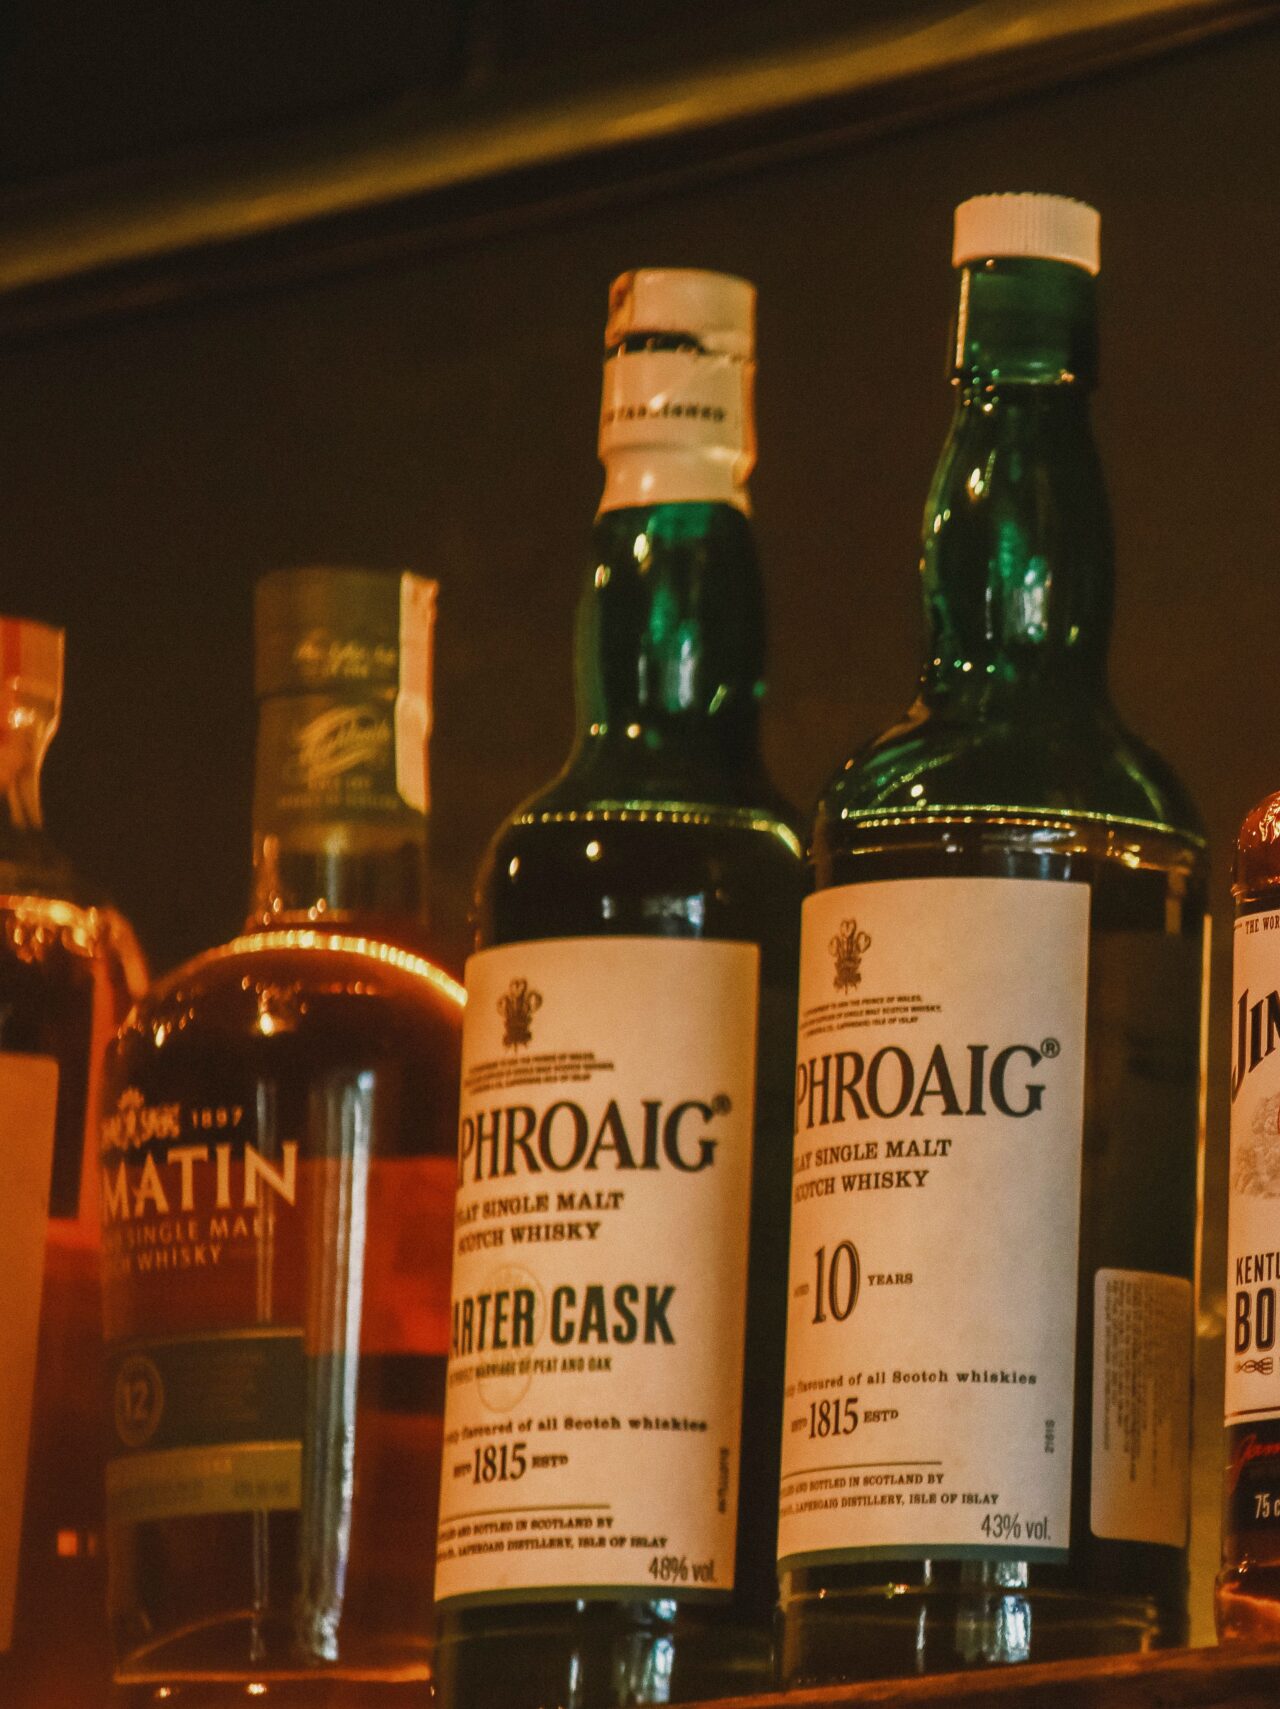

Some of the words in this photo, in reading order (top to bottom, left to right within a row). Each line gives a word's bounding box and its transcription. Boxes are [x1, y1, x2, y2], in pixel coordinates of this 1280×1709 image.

[1245, 918, 1260, 935] THE
[815, 1141, 878, 1166] SINGLE
[885, 1138, 952, 1159] MALT
[841, 1169, 930, 1192] WHISKY
[481, 1193, 549, 1220] SINGLE
[556, 1190, 625, 1212] MALT
[510, 1221, 601, 1246] WHISKY
[811, 1239, 861, 1325] 10
[867, 1273, 914, 1287] YEARS
[550, 1283, 677, 1346] CASK
[560, 1356, 585, 1373] AND
[588, 1355, 613, 1372] OAK
[848, 1372, 863, 1386] of
[866, 1371, 887, 1384] all
[892, 1369, 949, 1384] Scotch
[956, 1368, 1038, 1386] whiskies
[517, 1418, 534, 1433] of
[538, 1417, 558, 1432] all
[564, 1416, 622, 1431] Scotch
[628, 1415, 709, 1433] whiskies
[808, 1397, 859, 1440] 1815
[472, 1442, 528, 1486] 1815
[848, 1475, 860, 1488] IN
[862, 1473, 924, 1487] SCOTLAND
[927, 1473, 945, 1485] BY
[841, 1494, 906, 1509] DISTILLERY,
[909, 1493, 937, 1505] ISLE
[940, 1493, 958, 1505] OF
[961, 1493, 1000, 1505] ISLAY
[1254, 1492, 1271, 1519] 75
[516, 1519, 528, 1532] IN
[530, 1517, 593, 1531] SCOTLAND
[597, 1517, 615, 1529] BY
[980, 1512, 1022, 1540] 43%
[1026, 1515, 1051, 1541] vol.
[609, 1536, 627, 1549] OF
[648, 1555, 689, 1583] 48%
